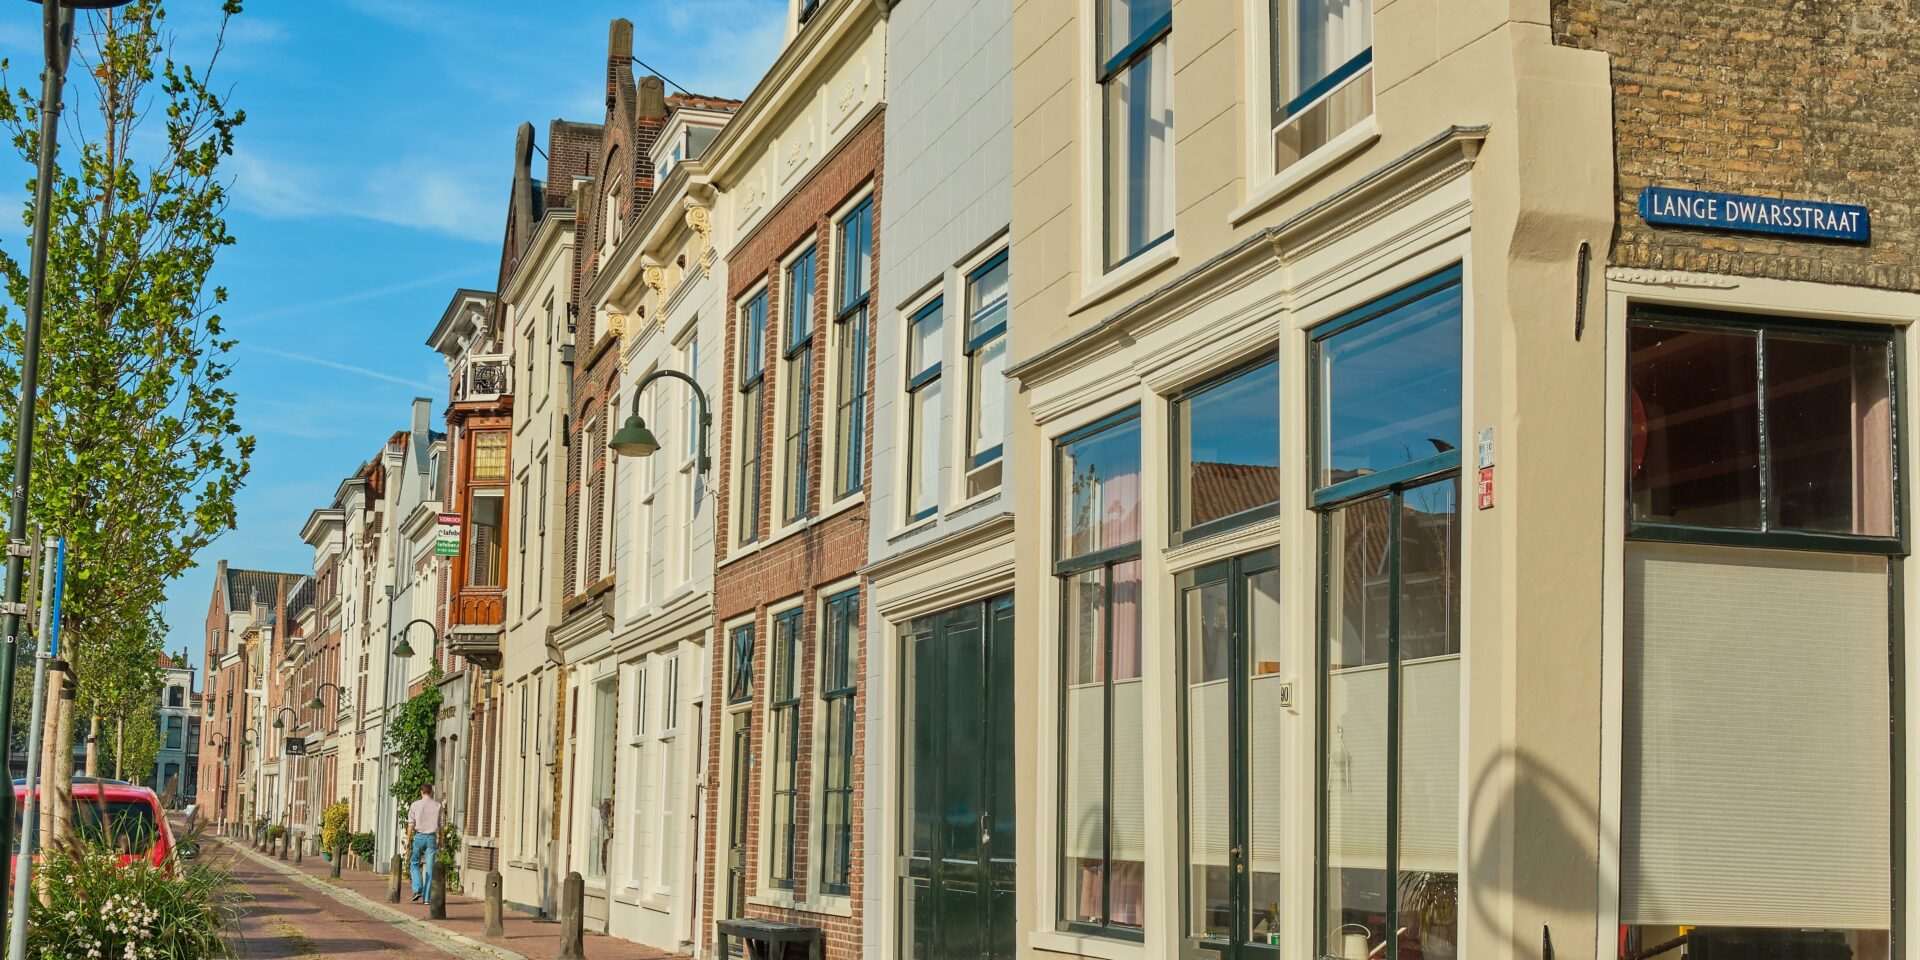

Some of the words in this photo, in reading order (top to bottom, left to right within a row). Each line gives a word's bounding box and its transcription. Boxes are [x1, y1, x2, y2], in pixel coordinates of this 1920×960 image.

[1654, 194, 1717, 220] LANGE
[1726, 200, 1860, 233] DWARSSTRAAT
[1281, 686, 1289, 701] 90
